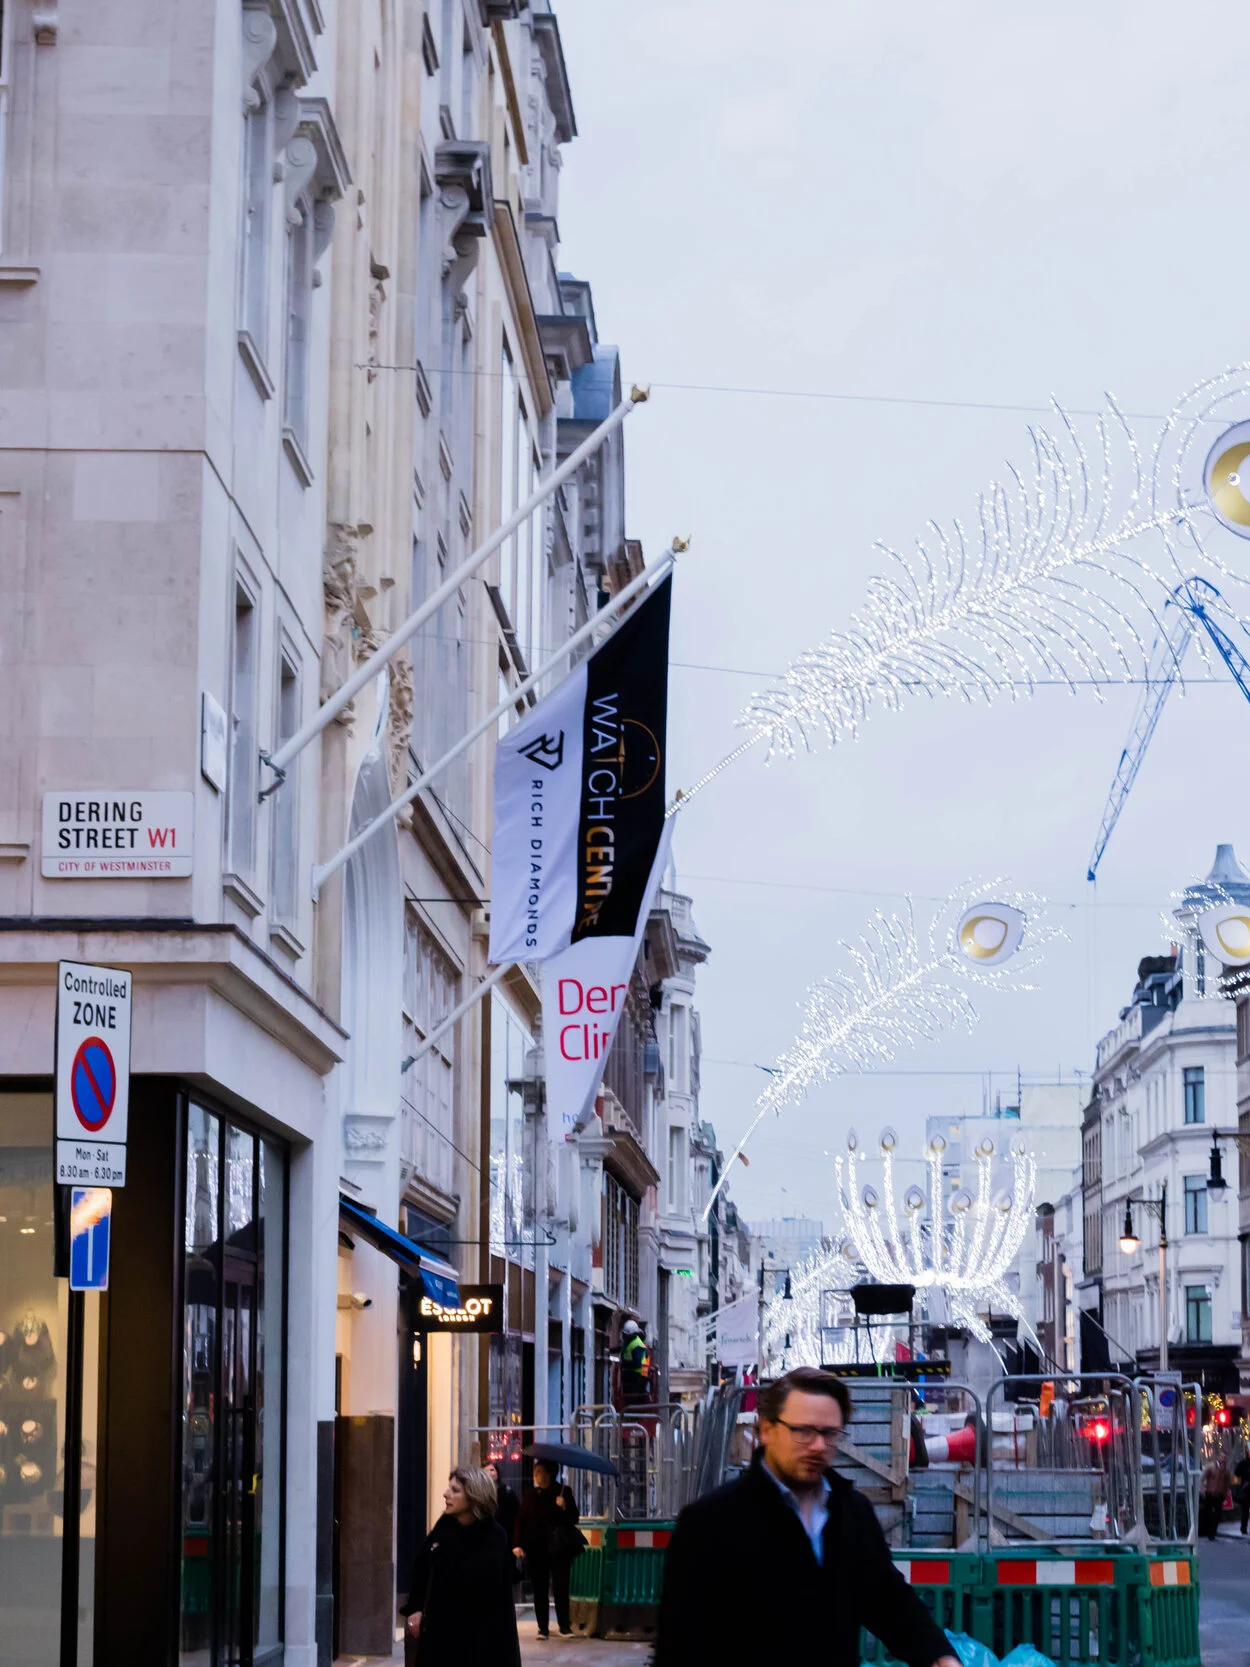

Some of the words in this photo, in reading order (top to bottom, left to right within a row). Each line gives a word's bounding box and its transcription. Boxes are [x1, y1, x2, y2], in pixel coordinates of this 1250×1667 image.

[59, 802, 143, 822] DERING
[531, 779, 543, 827] RICH
[58, 828, 139, 848] STREET
[148, 828, 176, 848] W1
[59, 861, 79, 872] CITY
[84, 862, 96, 871] OF
[100, 861, 171, 871] WESTMINSTER
[526, 839, 543, 947] DIAMONDS
[65, 972, 127, 999] Controlled
[73, 1002, 116, 1029] ZONE
[76, 1147, 91, 1160] Mon
[97, 1149, 109, 1162] Sat
[60, 1165, 77, 1178] 8.30
[79, 1168, 89, 1178] am
[94, 1167, 112, 1179] 6.30
[112, 1170, 123, 1182] pm
